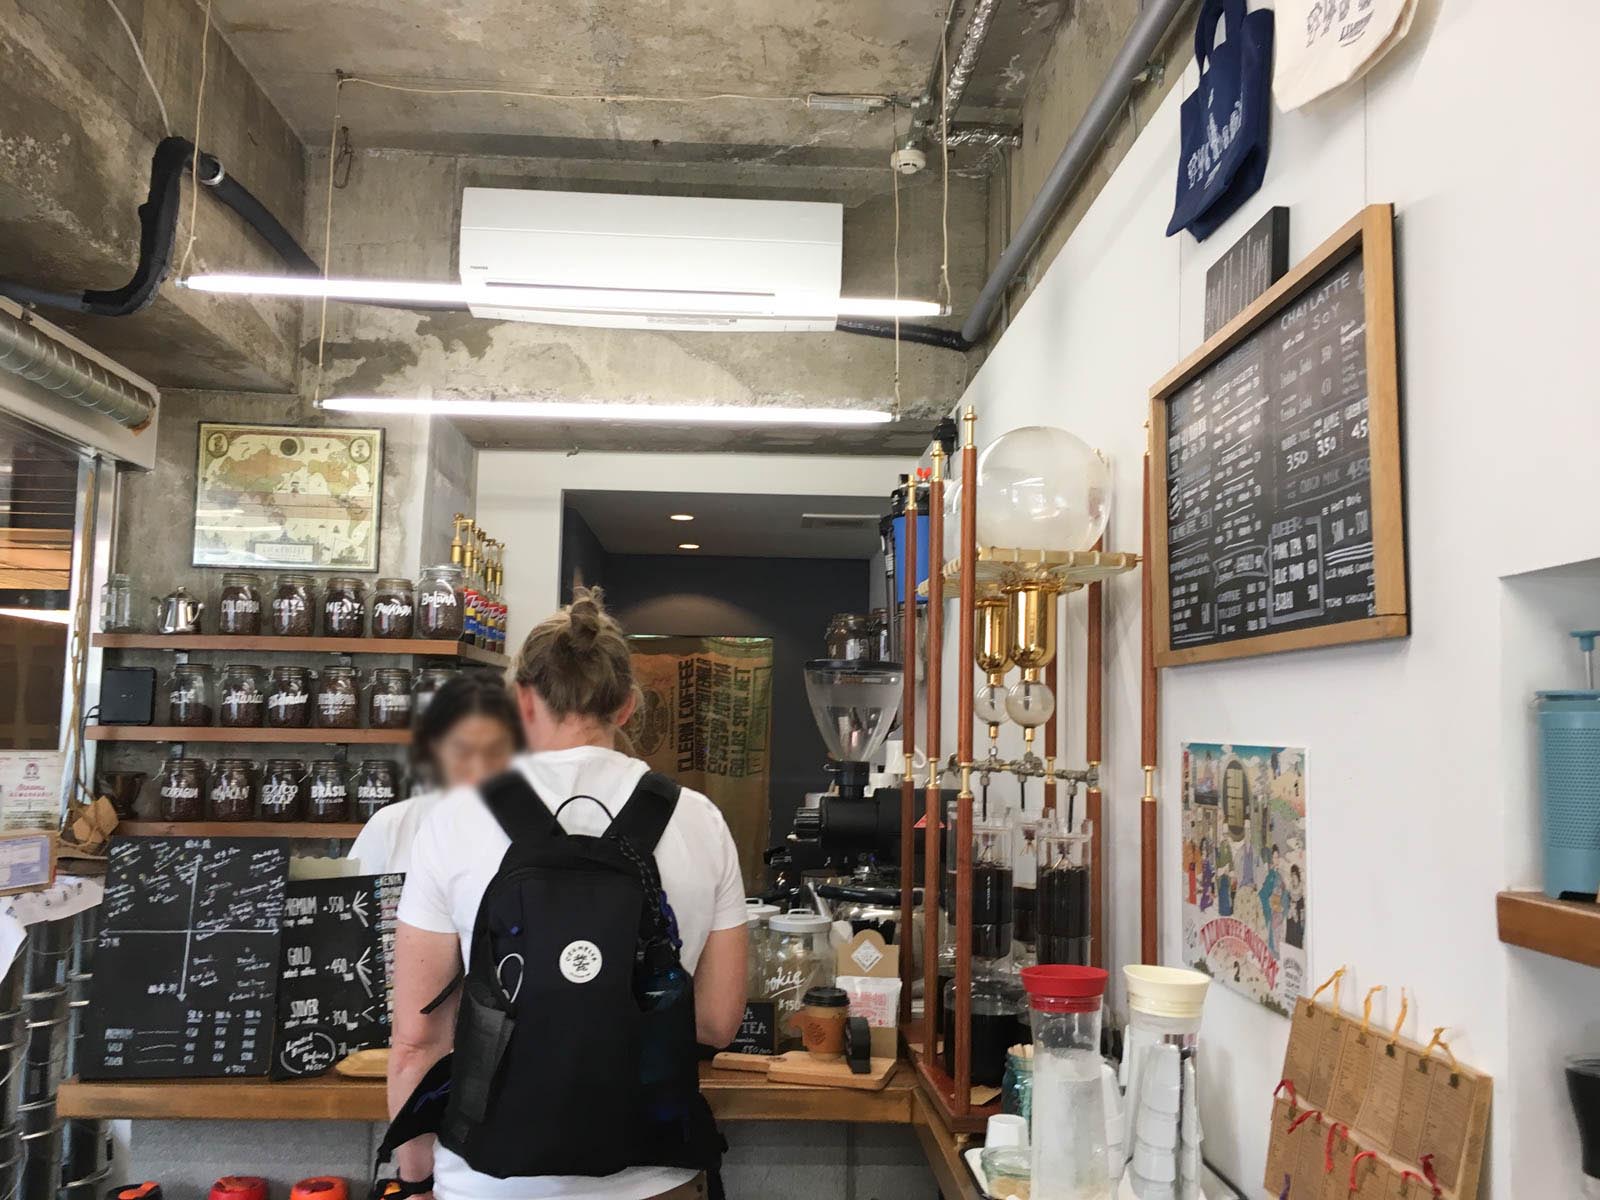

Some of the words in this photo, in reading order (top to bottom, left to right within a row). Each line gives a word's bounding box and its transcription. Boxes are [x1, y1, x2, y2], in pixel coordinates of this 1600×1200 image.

[1281, 302, 1308, 331] CHAI
[1309, 271, 1351, 312] LATTE
[1316, 436, 1337, 459] 350
[1286, 450, 1309, 473] 350
[1271, 516, 1303, 540] BEER
[677, 658, 695, 720] COFFEE
[287, 945, 312, 967] GOLD
[289, 998, 320, 1018] SILVER
